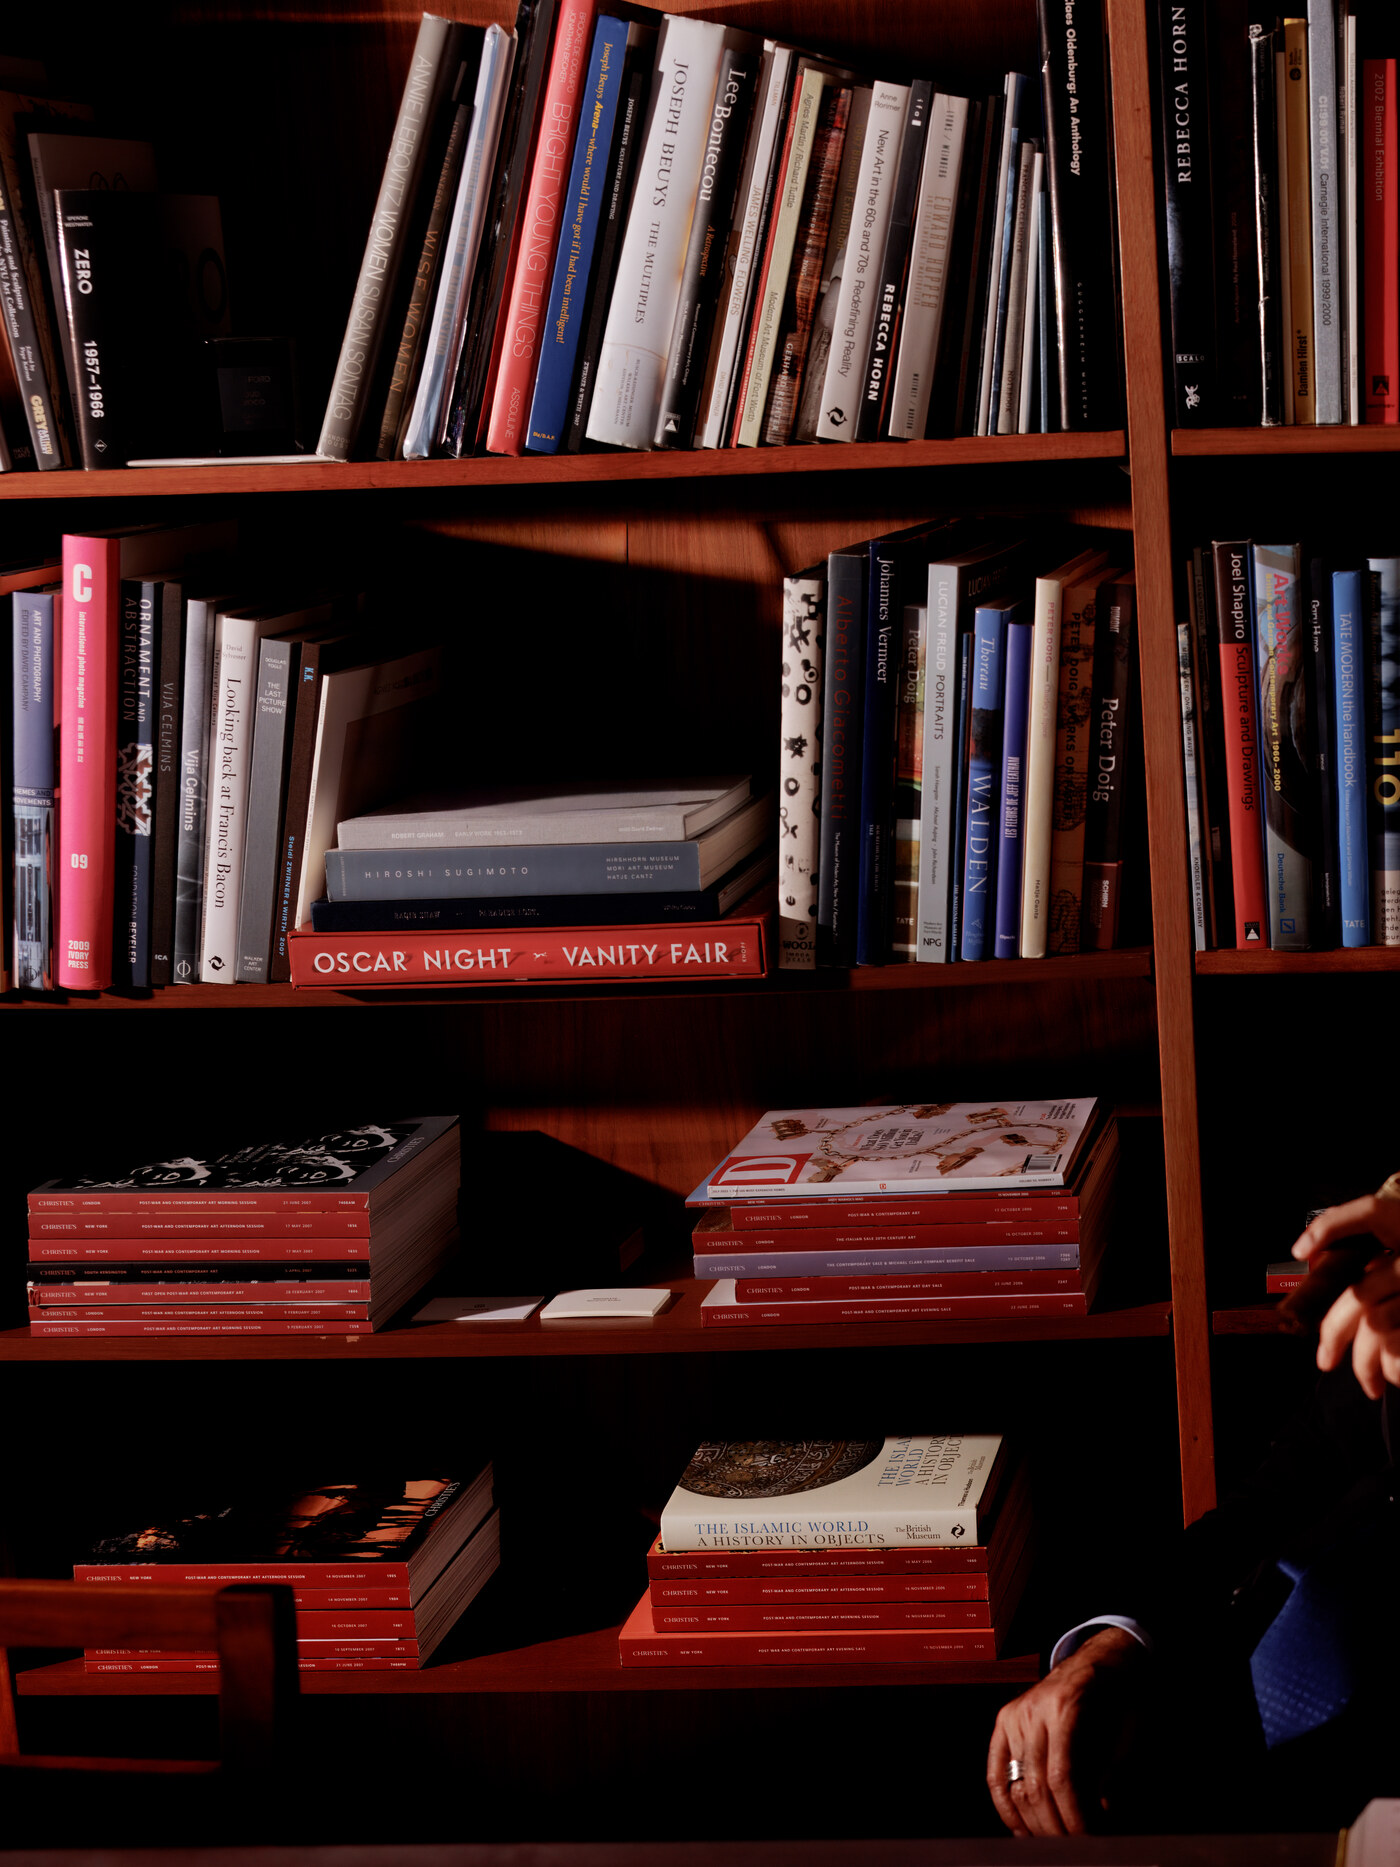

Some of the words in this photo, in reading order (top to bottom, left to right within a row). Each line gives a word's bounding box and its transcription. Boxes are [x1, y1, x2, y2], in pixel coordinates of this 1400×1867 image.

[1064, 0, 1076, 25] laes
[1065, 27, 1079, 95] Oldenburg:
[1171, 6, 1188, 73] HORN
[407, 55, 433, 114] ANNIE
[665, 59, 689, 135] JOSEPH
[723, 68, 748, 105] Lee
[1068, 96, 1080, 114] An
[542, 101, 572, 187] BRIGHT
[699, 103, 733, 202] Bontecou
[875, 129, 890, 156] New
[1069, 116, 1083, 176] Anthology
[1174, 82, 1192, 183] REBECCA
[387, 116, 420, 207] LEIBOVITZ
[652, 142, 676, 207] BEUYS
[870, 176, 882, 187] in
[872, 156, 885, 176] Art
[863, 207, 877, 229] 60s
[867, 188, 880, 207] the
[365, 210, 399, 282] WOMEN
[527, 191, 559, 273] YOUNG
[648, 222, 660, 248] THE
[859, 229, 871, 253] and
[73, 248, 94, 295] ZERO
[635, 252, 655, 324] MULTIPLES
[856, 254, 870, 274] 70s
[350, 283, 381, 347] SUSAN
[512, 279, 546, 362] THINGS
[843, 279, 866, 338] Redefining
[875, 283, 896, 352] REBECCA
[837, 340, 856, 378] Reality
[867, 357, 884, 401] HORN
[333, 348, 366, 421] SONTAG
[876, 556, 895, 621] Johannes
[1230, 552, 1246, 581] Joel
[1230, 584, 1248, 640] Shapiro
[1339, 612, 1353, 639] TATE
[876, 625, 892, 684] Vermeer
[1340, 641, 1355, 698] MODERN
[1234, 646, 1250, 714] Sculpture
[222, 678, 242, 743] Looking
[1099, 697, 1120, 750] Peter
[1239, 716, 1254, 743] and
[1342, 700, 1355, 722] the
[221, 746, 239, 780] back
[1094, 754, 1116, 803] Doig
[1240, 746, 1256, 811] Drawings
[1342, 723, 1358, 788] handbook
[220, 785, 231, 800] at
[217, 805, 235, 859] Francis
[968, 773, 993, 894] WALDEN
[70, 853, 88, 870] 09
[364, 869, 432, 879] HIROSHI
[444, 866, 529, 877] SUGIMOTO
[214, 863, 232, 909] Bacon
[313, 950, 408, 974] OSCAR
[423, 948, 511, 971] NIGHT
[562, 944, 658, 967] VANITY
[670, 942, 729, 965] FAIR
[923, 937, 942, 948] NPG
[694, 1523, 729, 1535] THE
[734, 1522, 802, 1534] ISLAMIC
[807, 1520, 869, 1533] WORLD
[698, 1537, 708, 1547] A
[713, 1535, 784, 1547] HISTORY
[791, 1535, 808, 1545] IN
[813, 1533, 885, 1547] OBJECTS
[905, 1524, 932, 1535] British
[906, 1531, 941, 1540] Museum
[661, 1563, 698, 1571] CHRISTIE'S
